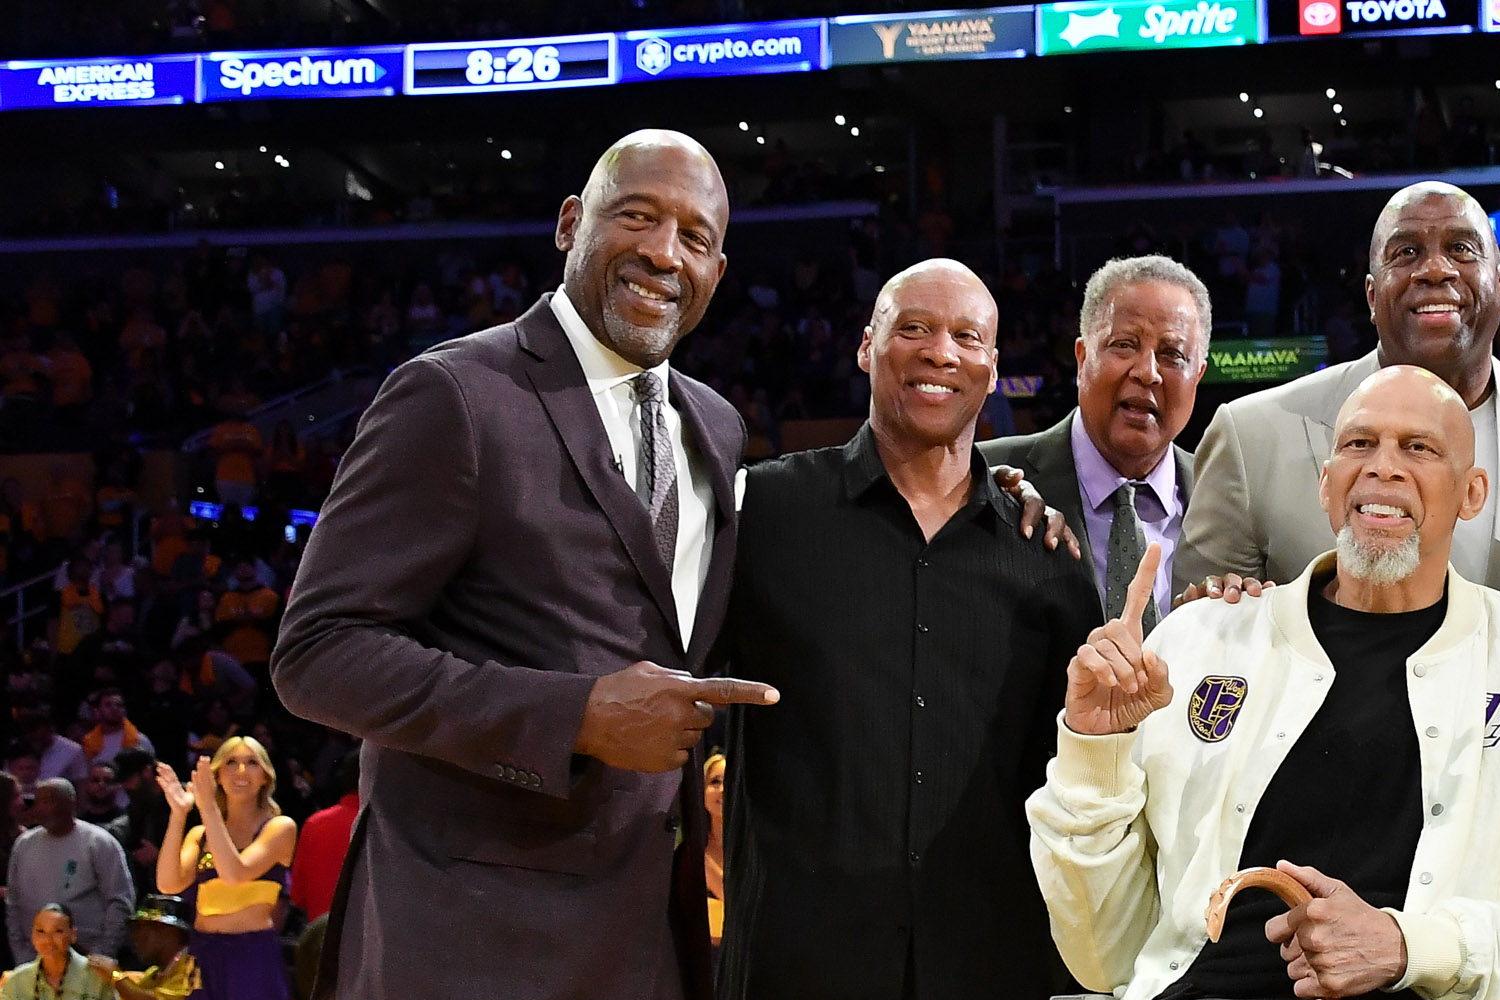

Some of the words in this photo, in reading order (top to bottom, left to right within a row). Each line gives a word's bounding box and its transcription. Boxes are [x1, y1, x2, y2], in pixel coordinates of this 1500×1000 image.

[1138, 1, 1238, 43] Sprite
[1347, 0, 1446, 22] TOYOTA
[673, 36, 802, 64] crypto.com
[38, 62, 153, 86] AMERICAN
[220, 56, 376, 96] Spectrum
[465, 45, 561, 85] 8:26
[54, 81, 155, 103] EXPRESS
